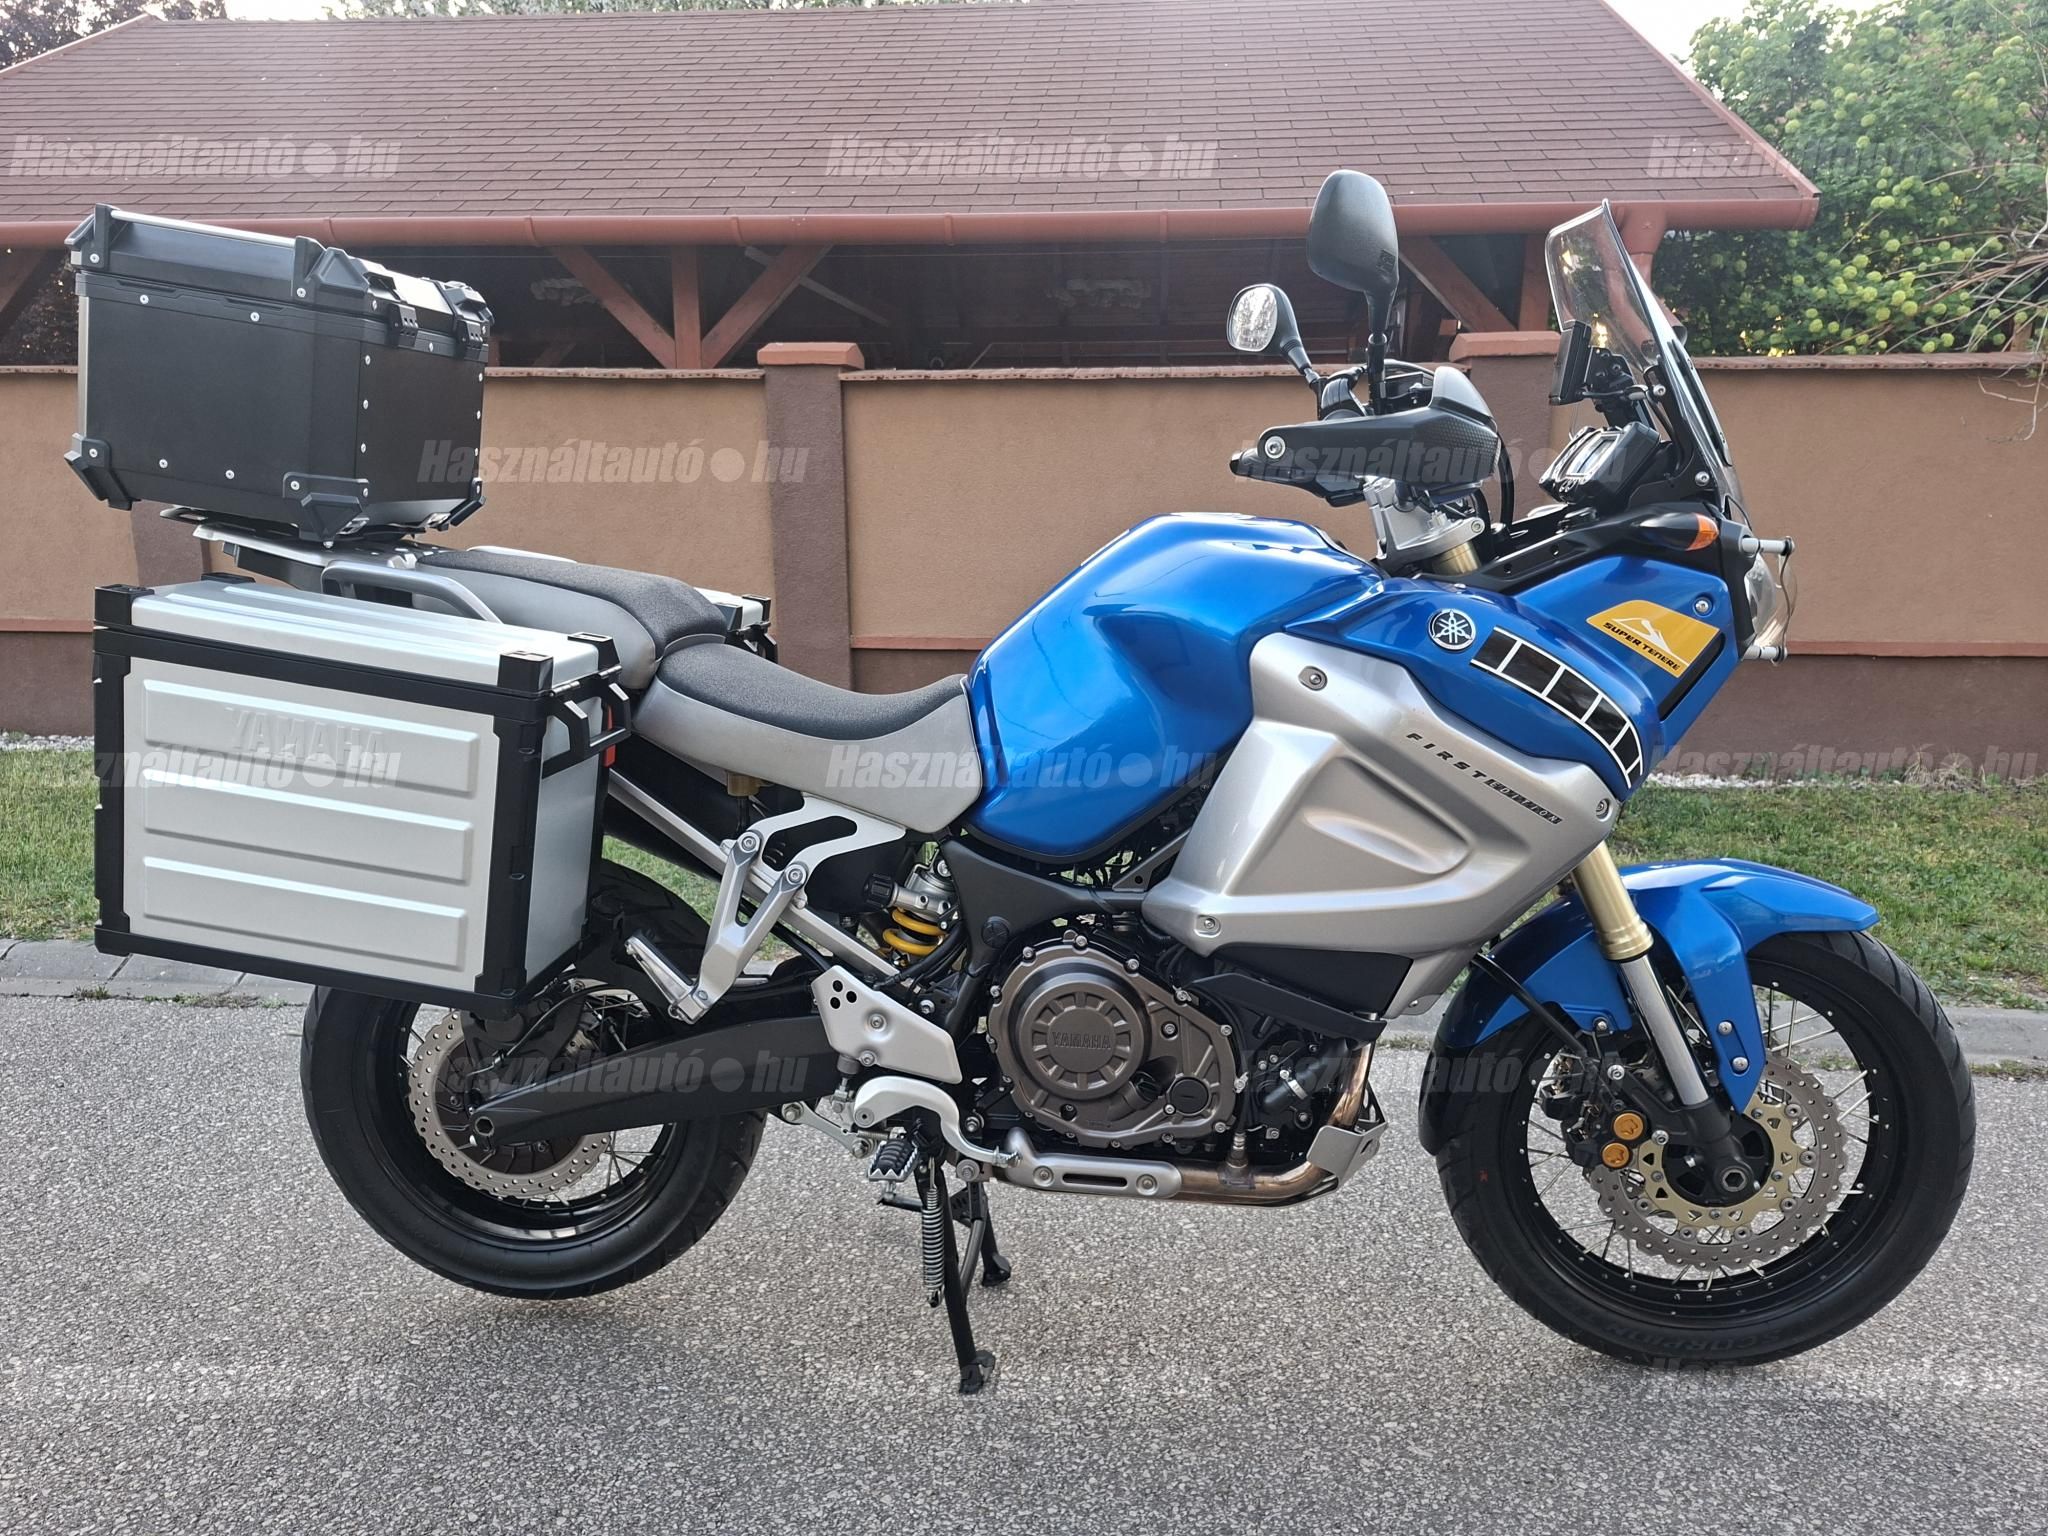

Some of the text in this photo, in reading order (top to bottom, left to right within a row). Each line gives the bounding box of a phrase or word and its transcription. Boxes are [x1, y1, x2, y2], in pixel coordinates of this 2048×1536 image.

[1603, 622, 1642, 646] SUPER
[1406, 733, 1487, 779] FIRST
[1052, 1031, 1112, 1050] YAMAHA
